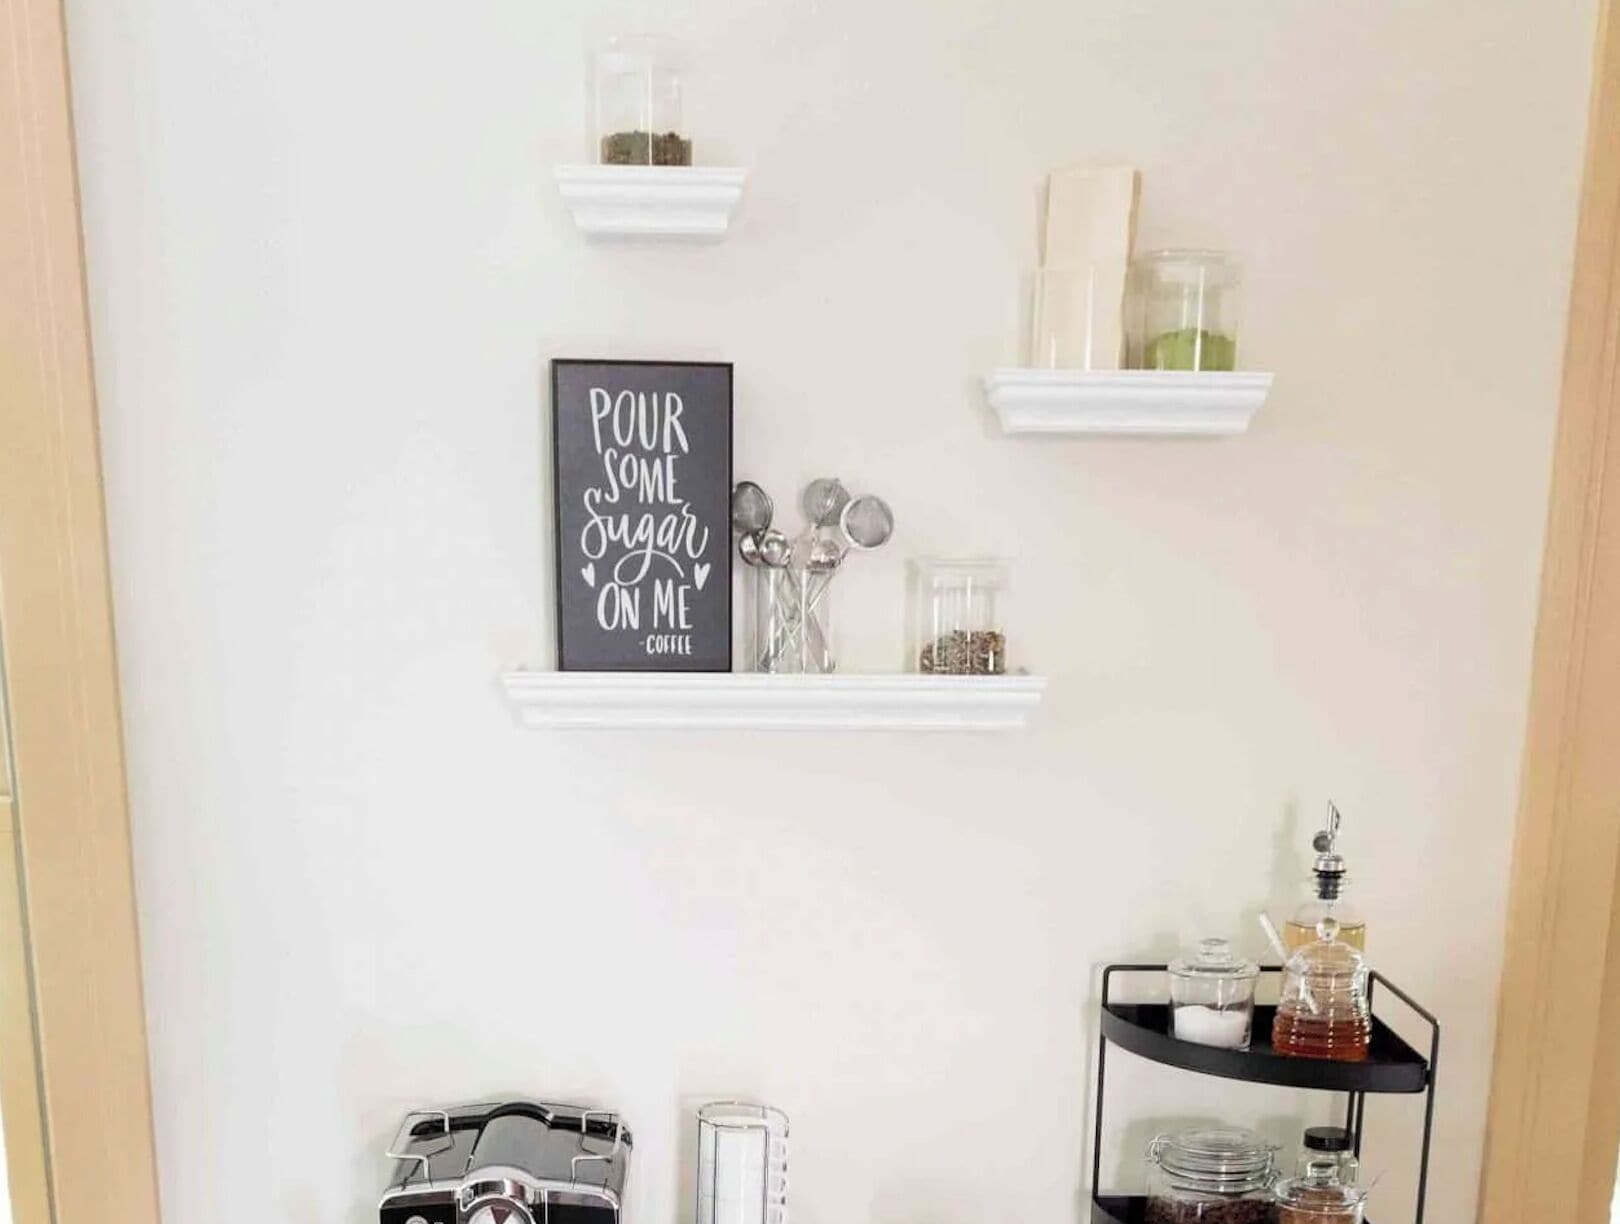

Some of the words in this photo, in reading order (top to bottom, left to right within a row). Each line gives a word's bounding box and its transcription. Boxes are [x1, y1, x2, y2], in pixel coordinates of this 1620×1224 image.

[589, 387, 689, 454] POUR
[604, 447, 683, 504] SOME
[580, 487, 709, 586] Sugar
[597, 581, 640, 630] ON
[653, 578, 693, 630] ME
